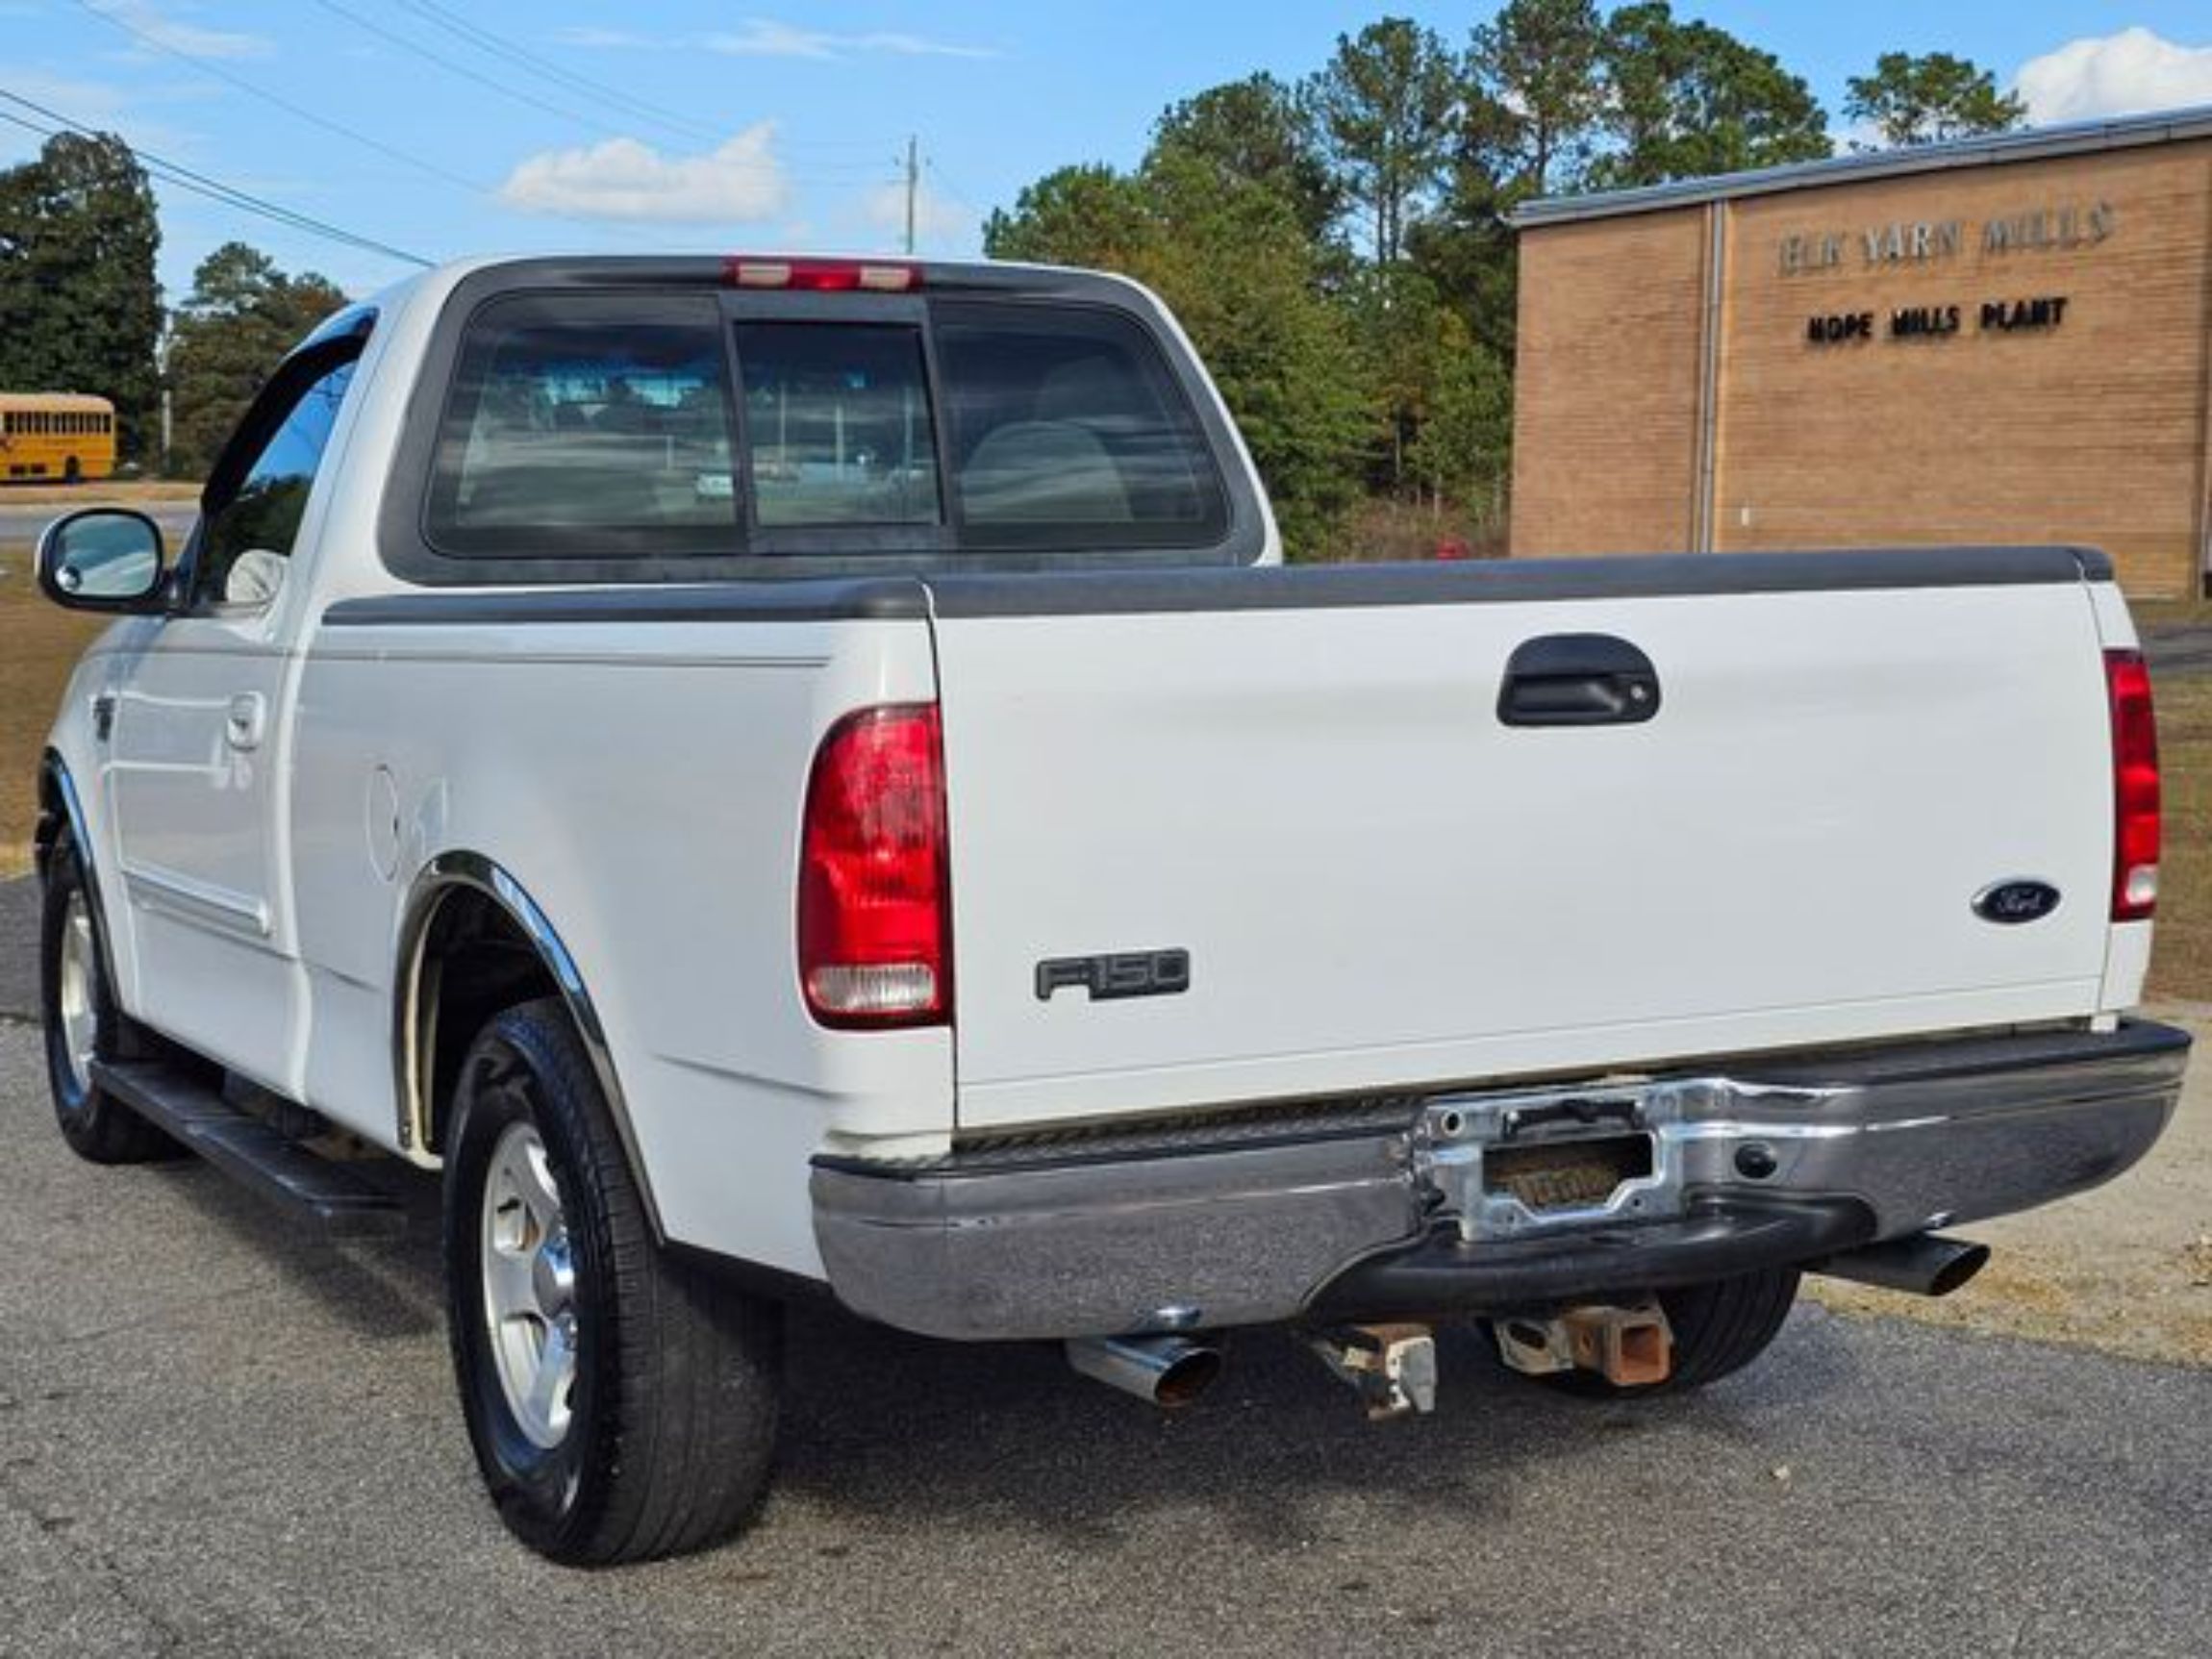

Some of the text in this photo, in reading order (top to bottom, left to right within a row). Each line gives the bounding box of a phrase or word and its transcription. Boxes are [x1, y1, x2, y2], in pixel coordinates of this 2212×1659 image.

[1864, 218, 1962, 264] YARN
[1984, 201, 2114, 256] MILLS
[1808, 297, 2068, 342] HOPE MILLS PLANT
